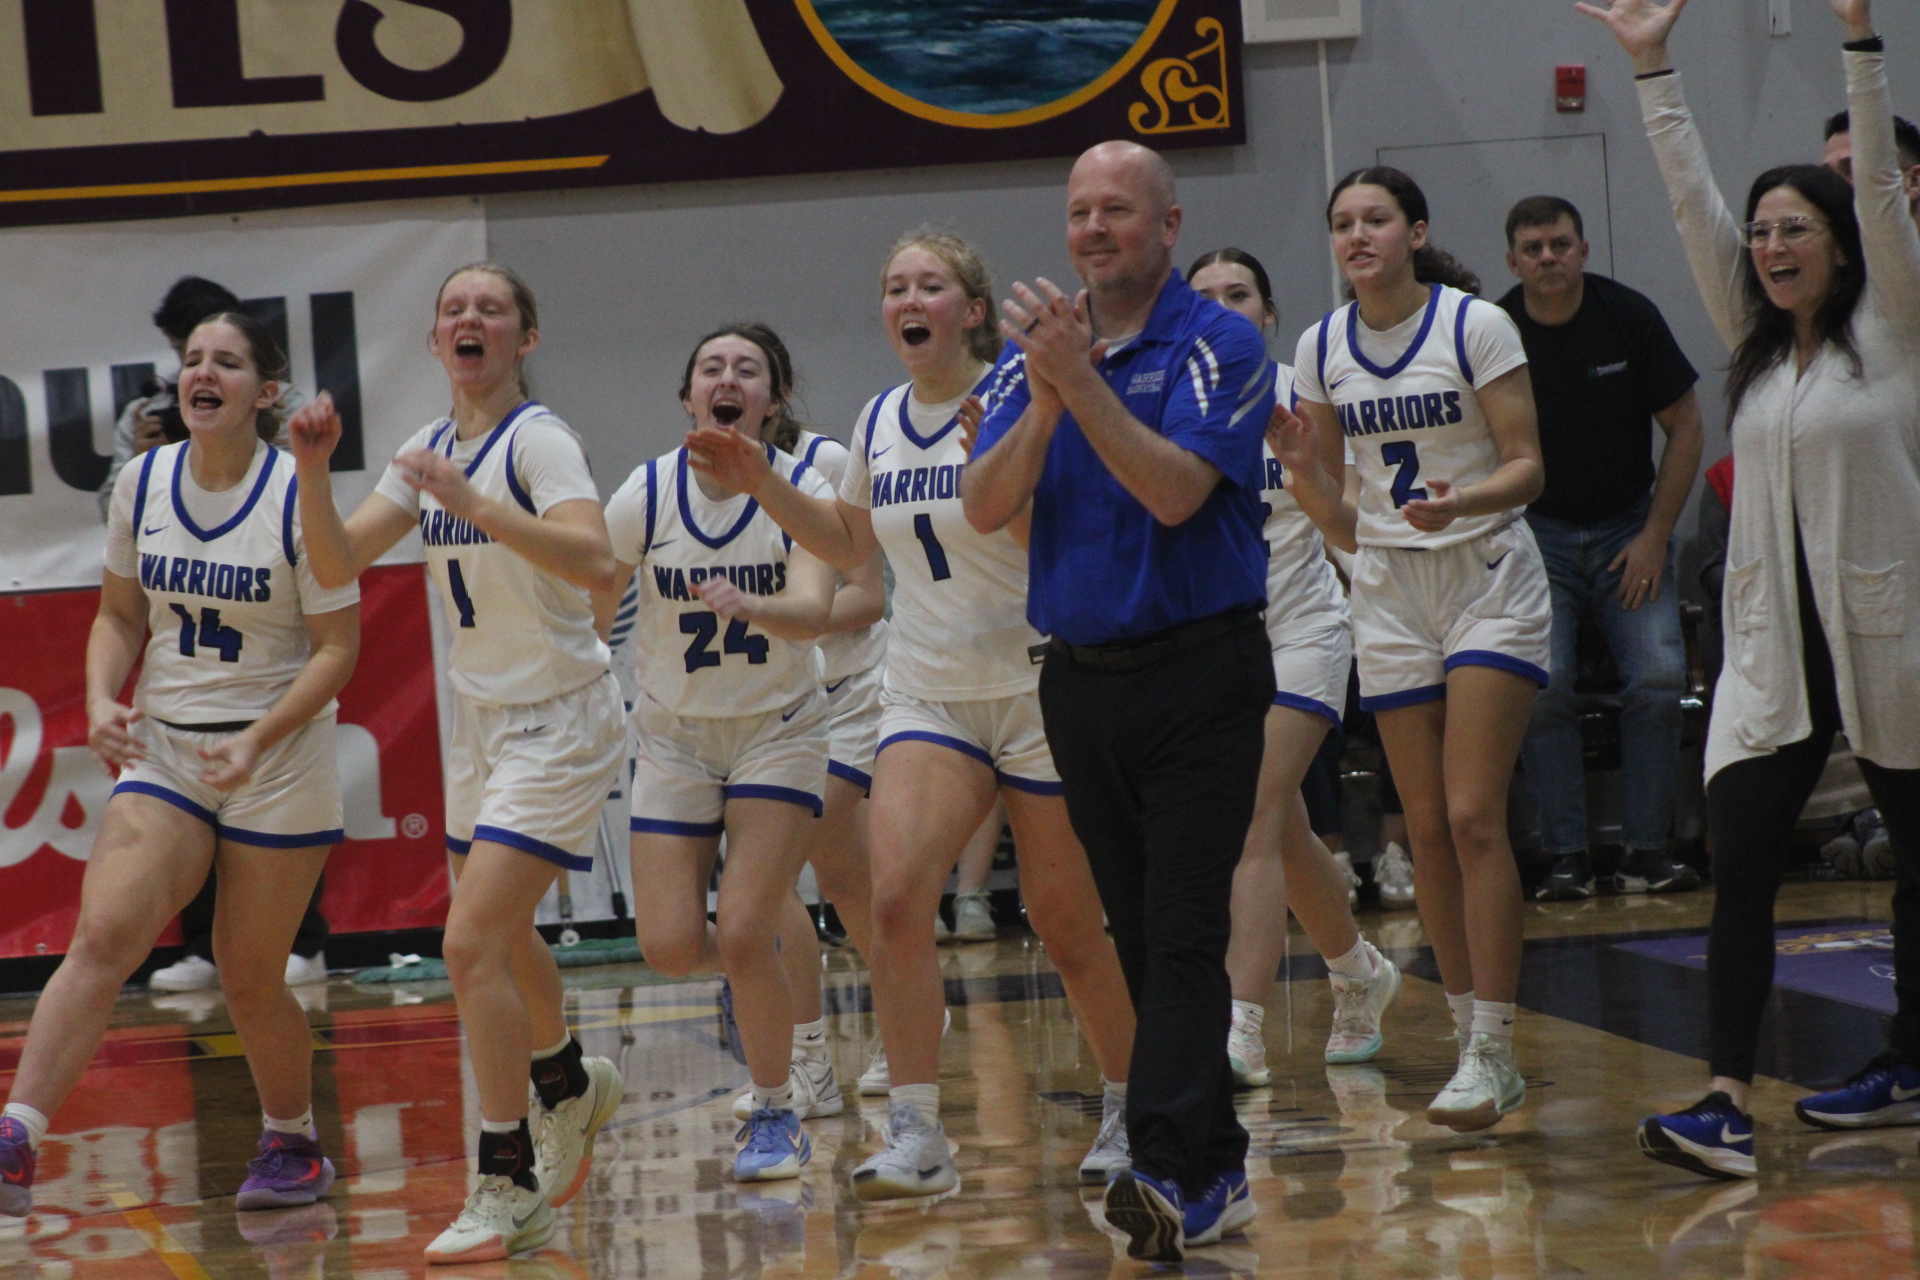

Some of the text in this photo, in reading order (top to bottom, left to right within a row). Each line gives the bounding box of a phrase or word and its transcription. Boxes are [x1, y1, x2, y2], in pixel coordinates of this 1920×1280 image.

[1381, 440, 1428, 509] 2
[141, 553, 271, 602] WARRIORS
[913, 513, 951, 581] 1
[447, 558, 476, 628] 1
[168, 602, 243, 663] 14
[679, 610, 770, 673] 24
